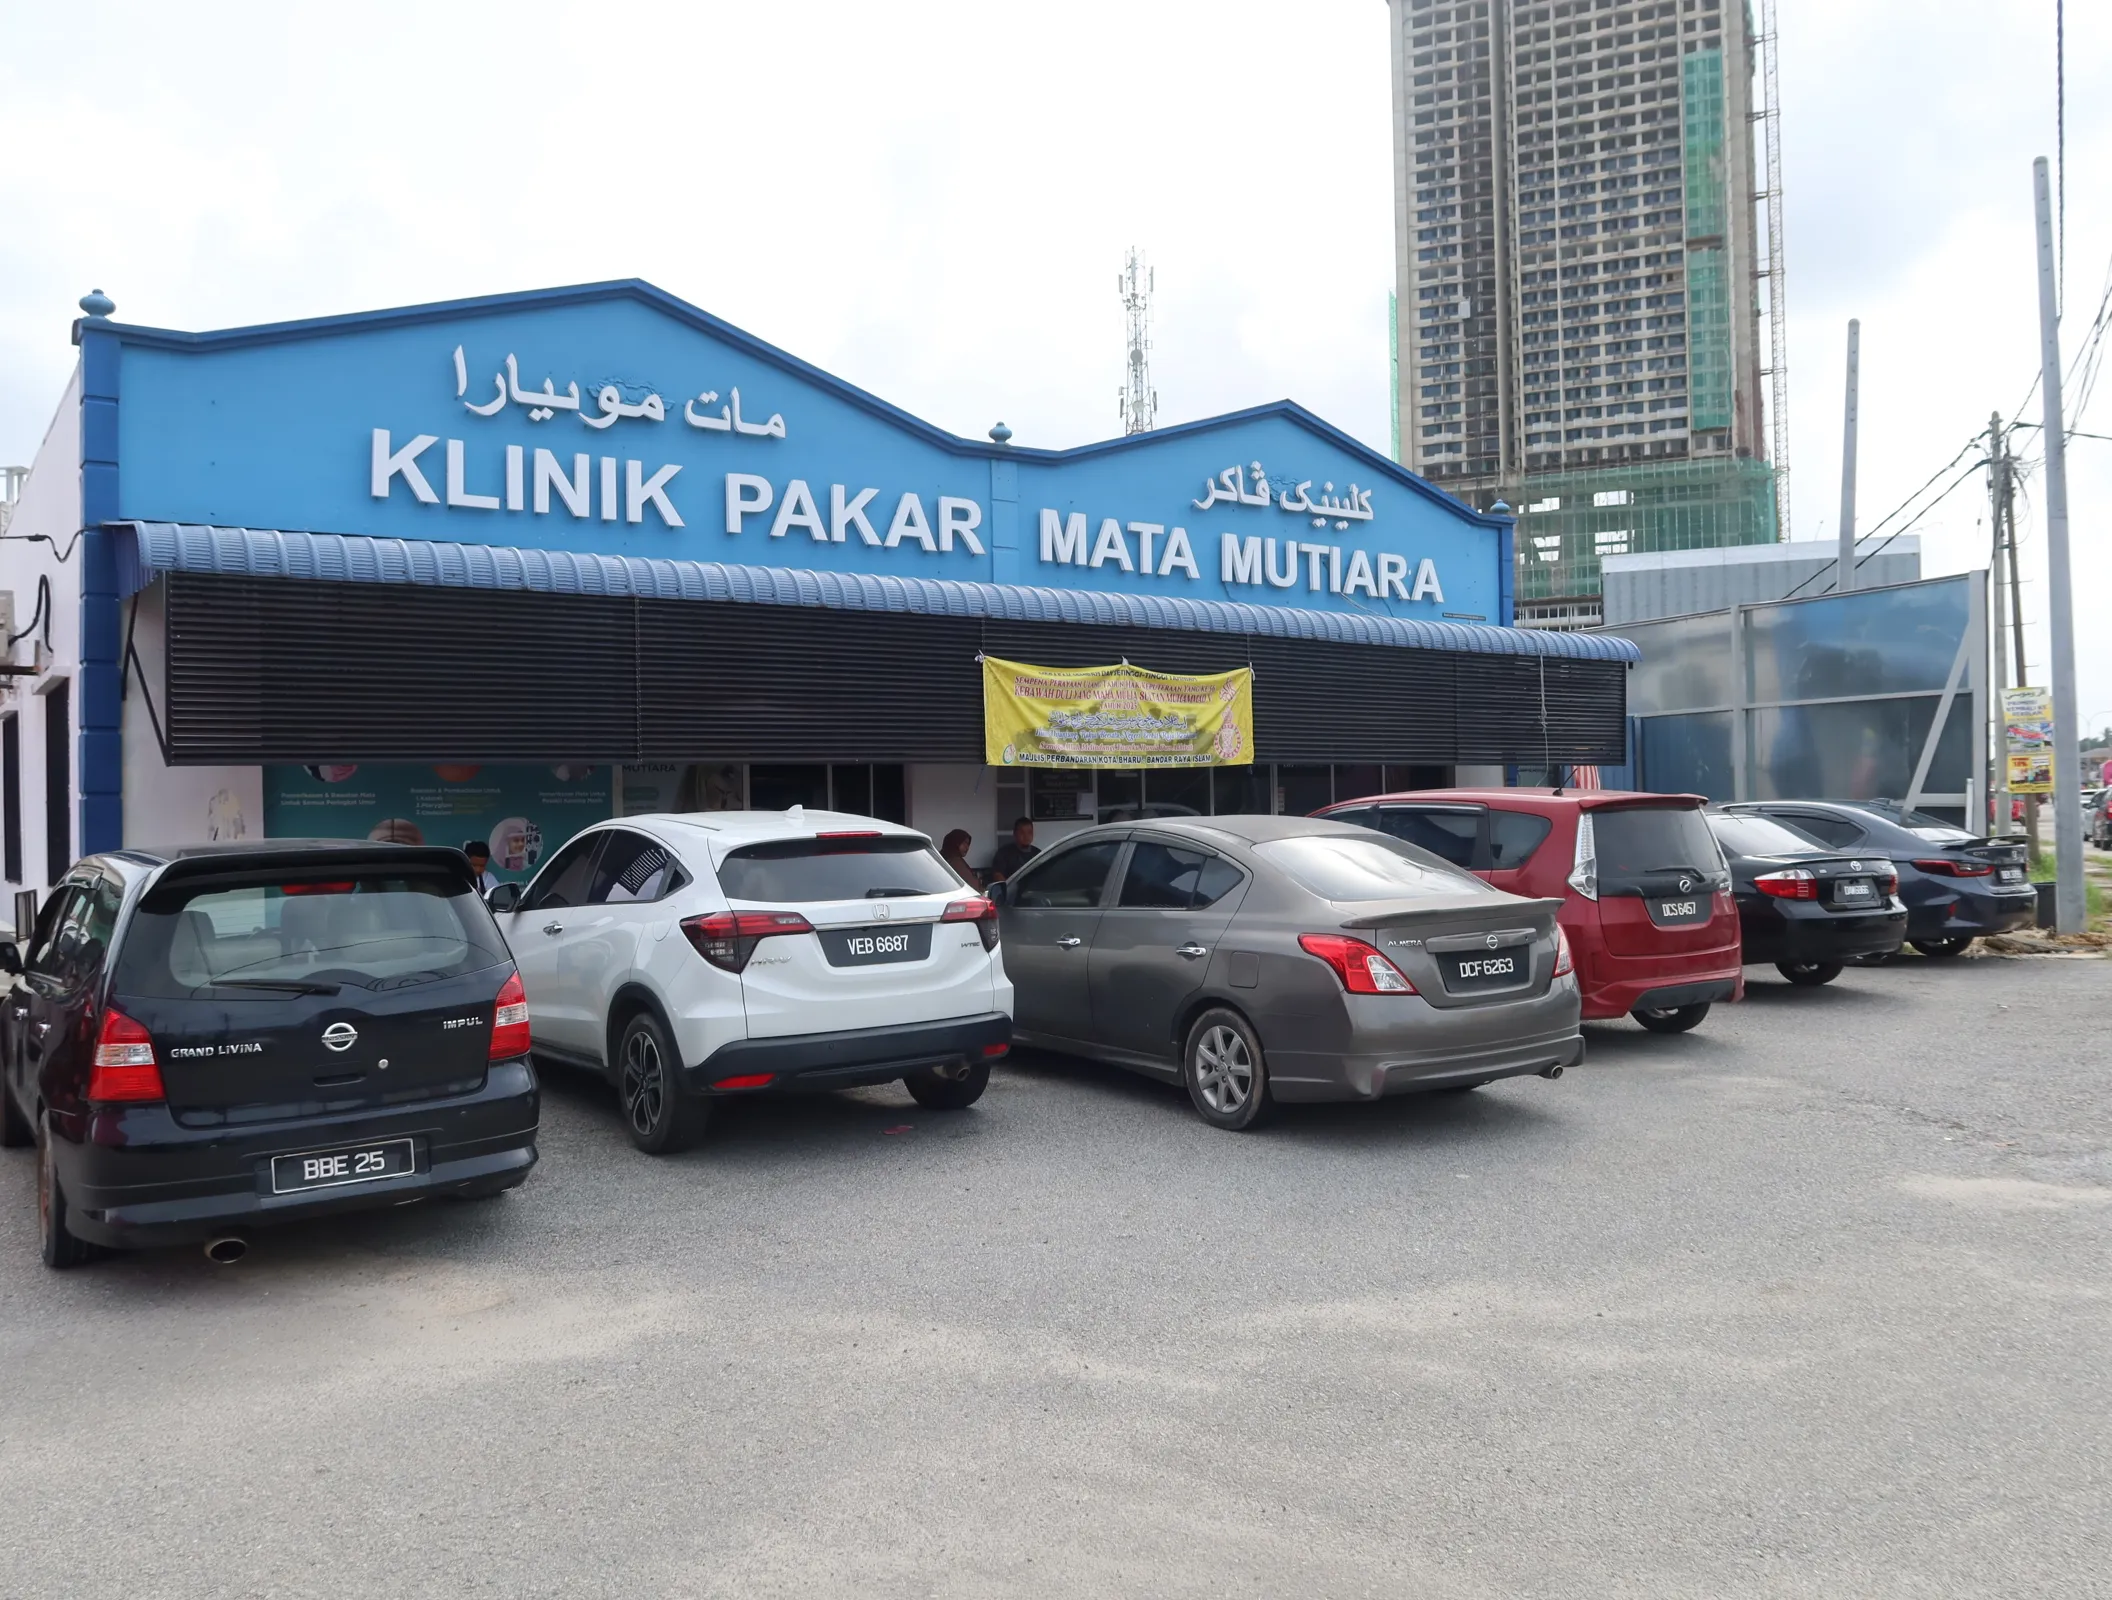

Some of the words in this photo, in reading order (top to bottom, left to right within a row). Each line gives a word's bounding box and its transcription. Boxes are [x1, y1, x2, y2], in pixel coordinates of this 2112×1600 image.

[684, 386, 786, 439] مات
[371, 428, 686, 528] KLINIK
[724, 473, 986, 555] PAKAR
[1040, 508, 1200, 580] MATA
[1221, 533, 1445, 604] MUTIARA
[1015, 676, 1048, 687] SEMPENA
[1049, 678, 1082, 688] PERAYAAN
[1014, 685, 1054, 698] KEBAWAH
[1056, 689, 1073, 700] DULI
[1019, 753, 1045, 762] MAJLIS
[1047, 754, 1097, 764] PERBANDARAN
[1099, 755, 1117, 764] KOTA
[1119, 755, 1142, 764] BHARU
[1146, 755, 1173, 764] BANDAR
[1174, 755, 1191, 764] RAYA
[1192, 754, 1212, 764] ISLAM
[622, 764, 677, 773] MUTIARA
[847, 936, 874, 955] VEB
[876, 935, 909, 952] 6687
[1387, 939, 1423, 947] ALMERA
[1459, 961, 1482, 978] DCF
[1483, 957, 1514, 976] 6263
[443, 1016, 483, 1030] IMPUL
[171, 1046, 214, 1058] GRAND
[303, 1155, 349, 1180] BBE
[354, 1150, 386, 1173] 25
